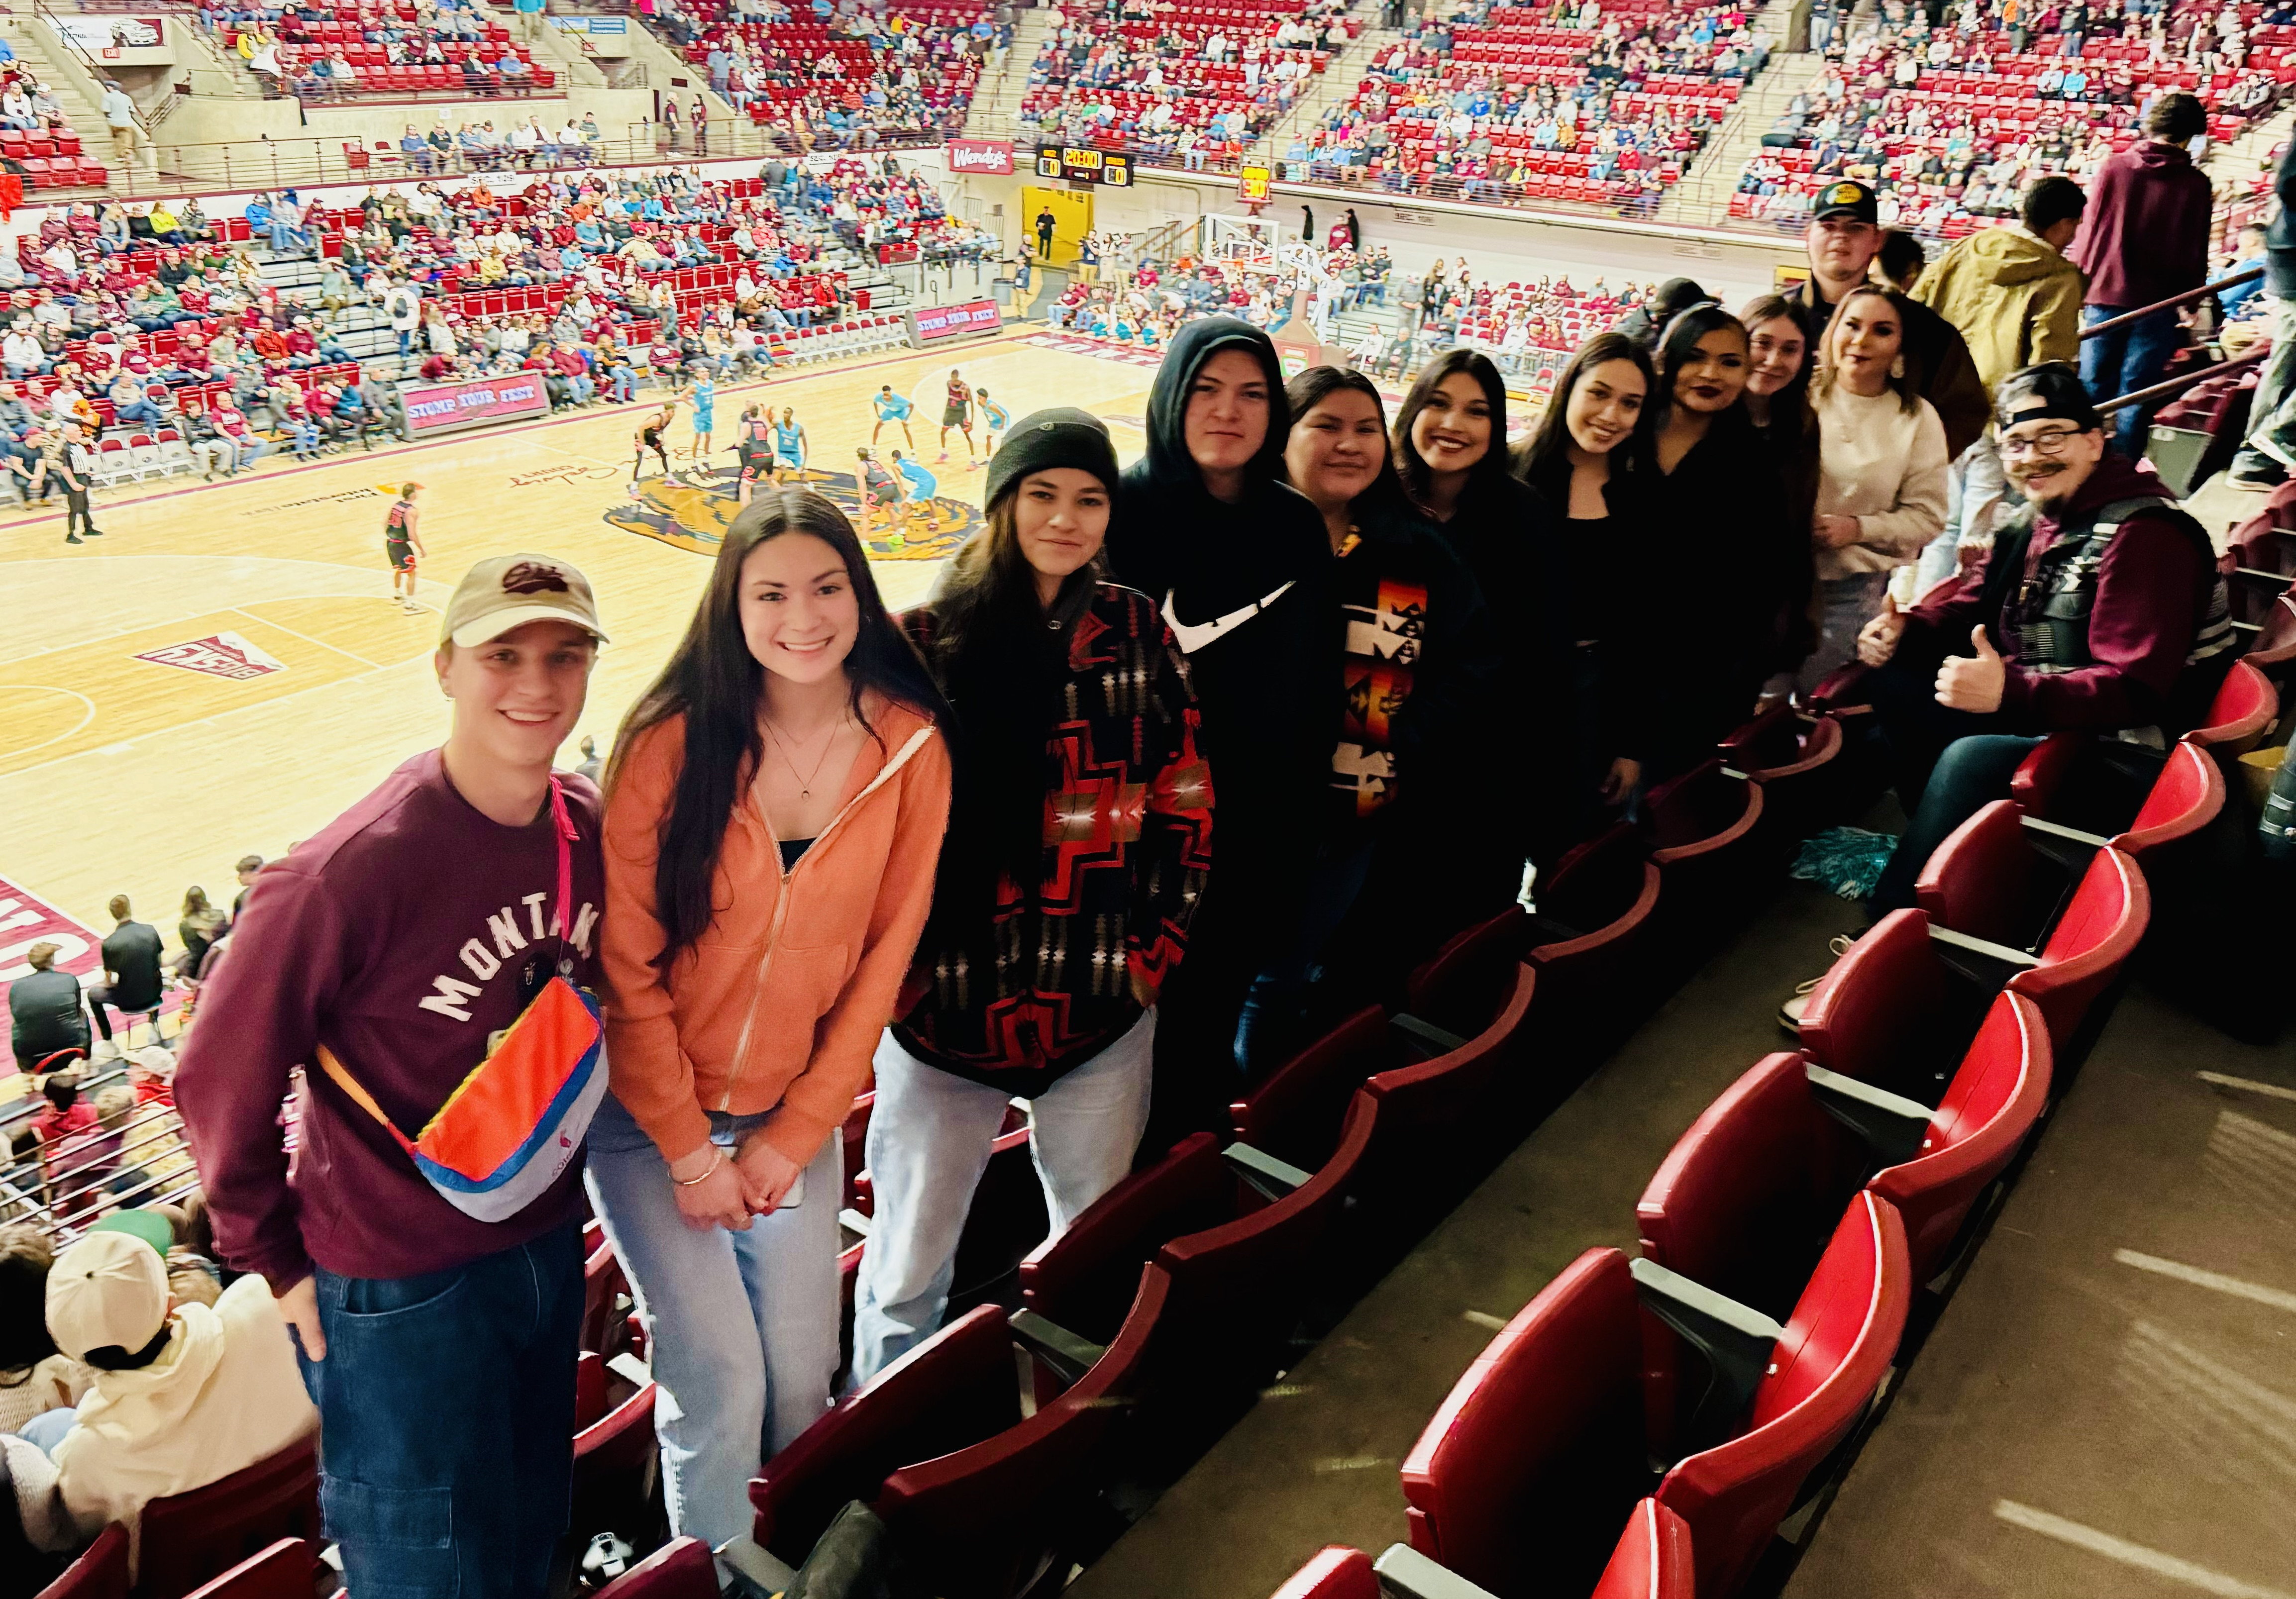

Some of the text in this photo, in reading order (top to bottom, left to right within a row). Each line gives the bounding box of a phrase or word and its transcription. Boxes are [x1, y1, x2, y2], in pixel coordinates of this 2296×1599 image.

[954, 146, 1007, 170] Wendy's
[1066, 150, 1098, 167] 20:00
[1049, 161, 1058, 175] 0
[1115, 169, 1124, 184] 0
